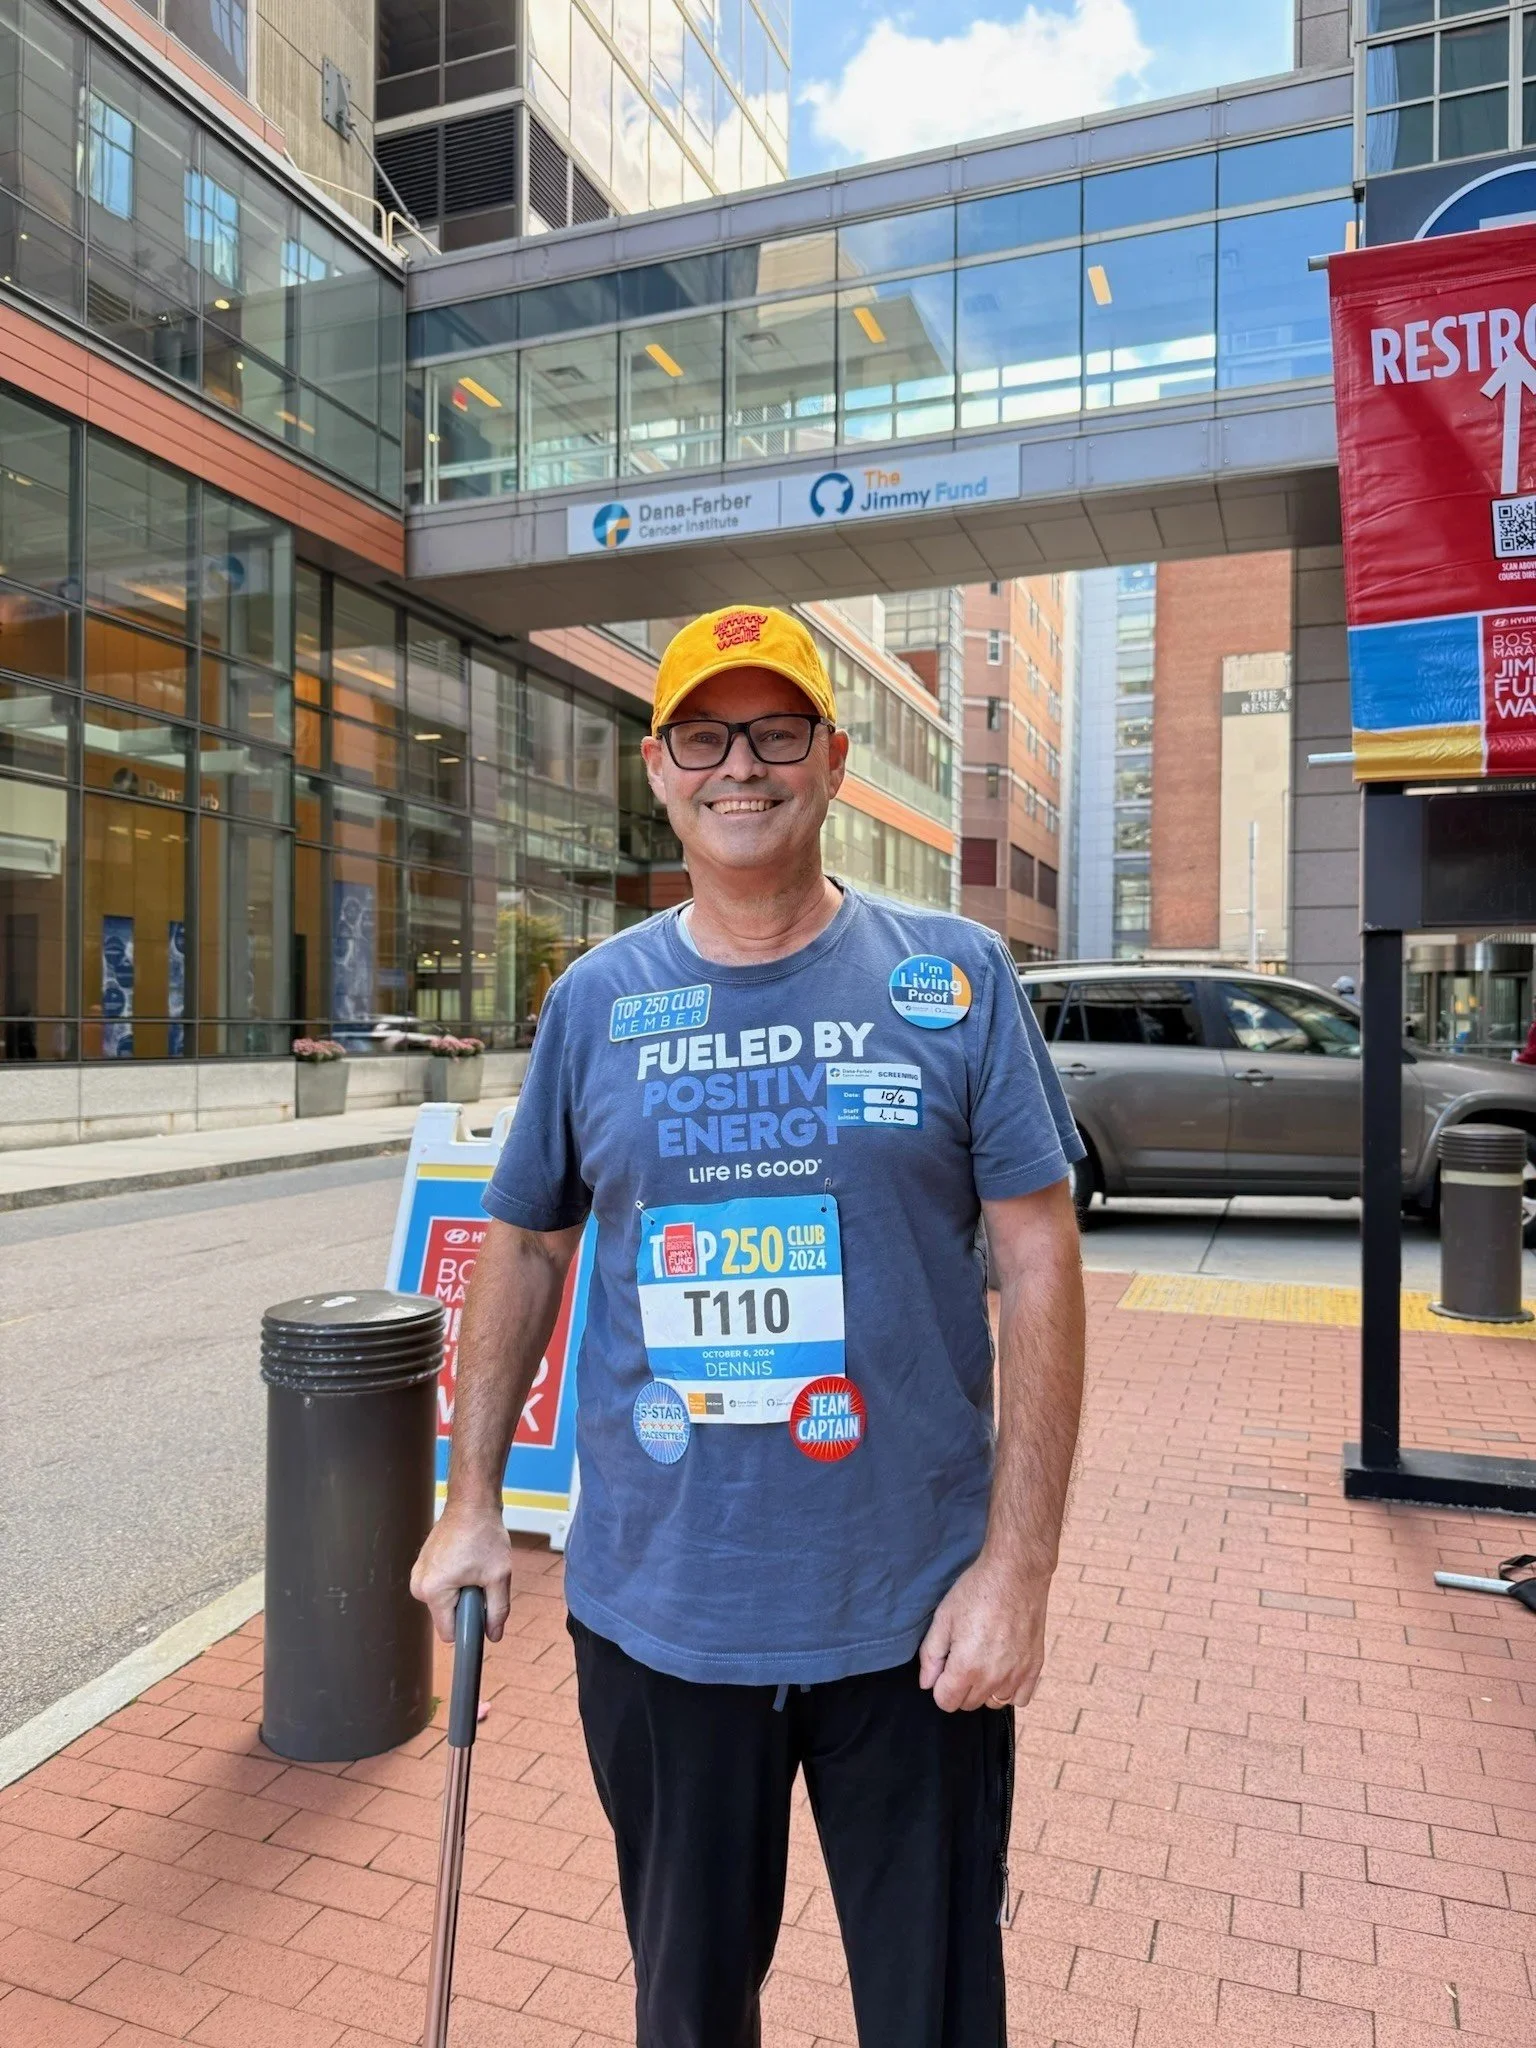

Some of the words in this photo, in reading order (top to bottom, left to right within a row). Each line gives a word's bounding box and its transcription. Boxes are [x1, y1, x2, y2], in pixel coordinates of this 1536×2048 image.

[864, 469, 900, 490] The
[861, 489, 931, 511] Jimmy
[935, 477, 988, 502] Fund
[639, 494, 752, 522] Dana-Farber
[639, 524, 682, 538] Cancer
[686, 516, 739, 533] Institute
[1498, 571, 1521, 581] COURSE
[1502, 562, 1519, 571] SCAN
[1493, 644, 1536, 659] MARA
[1495, 657, 1536, 678] JIM
[1248, 689, 1280, 702] THE
[1495, 676, 1536, 699] FU
[920, 962, 943, 975] I'm
[901, 972, 962, 996] Living
[617, 1000, 642, 1020] TOP
[643, 996, 669, 1015] 250
[671, 989, 705, 1011] CLUB
[908, 988, 949, 1003] Proof
[614, 1010, 702, 1036] MEMBER
[637, 1025, 803, 1081] FUELED
[813, 1021, 875, 1058] BY
[878, 1071, 919, 1081] SCREENING
[642, 1062, 826, 1117] POSITIV
[881, 1086, 905, 1106] 10/6
[735, 1163, 752, 1180] IS
[787, 1224, 826, 1247] CLUB
[721, 1225, 784, 1276] 250
[789, 1249, 828, 1272] 2024
[668, 1257, 694, 1266] FUND
[670, 1265, 694, 1274] WALK
[684, 1288, 790, 1337] T110
[702, 1350, 741, 1358] OCTOBER
[743, 1350, 751, 1358] 6,
[753, 1349, 775, 1357] 2024
[706, 1361, 772, 1377] DENNIS
[640, 1405, 682, 1420] 5-STAR
[810, 1395, 849, 1416] TEAM
[798, 1417, 859, 1440] CAPTAIN
